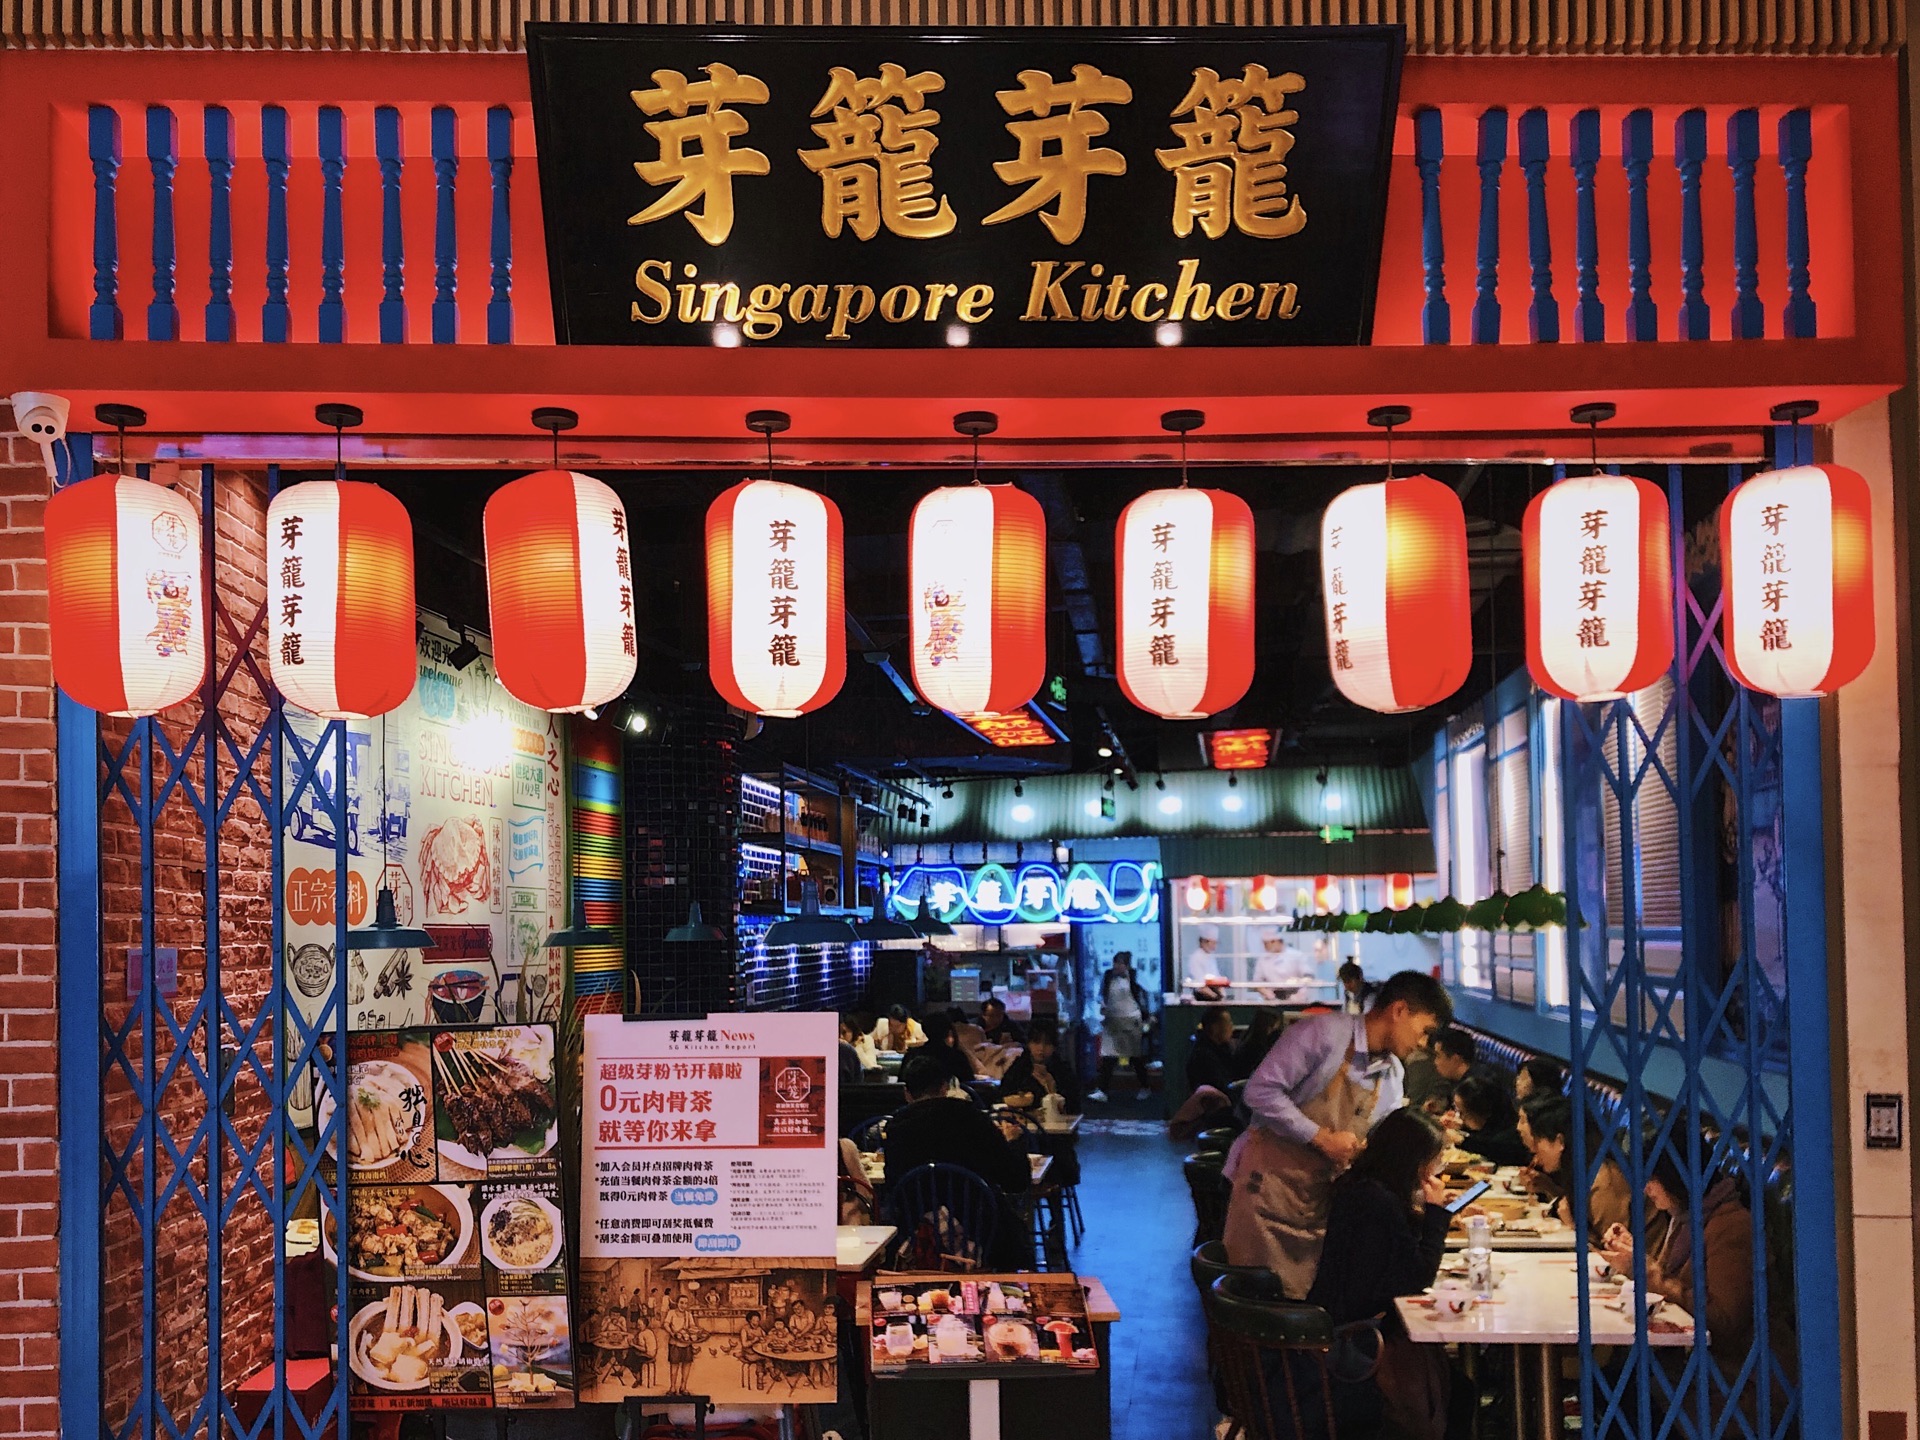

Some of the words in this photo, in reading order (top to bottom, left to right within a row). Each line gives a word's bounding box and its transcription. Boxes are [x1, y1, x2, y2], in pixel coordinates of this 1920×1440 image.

[627, 62, 1307, 245] 芽籠芽籠
[631, 259, 995, 341] Singapore
[1019, 259, 1300, 323] Kitchen
[280, 515, 305, 666] 芽籠芽籠
[612, 507, 636, 658] 芽籠芽籠
[1576, 509, 1611, 649] 芽籠芽籠
[1759, 503, 1792, 651] 芽籠芽籠
[767, 519, 801, 667] 芽籠芽籠
[1149, 522, 1180, 667] 芽籠芽籠
[419, 636, 457, 667] 欢迎光
[419, 663, 464, 688] welcome
[419, 764, 494, 806] KITCHEN
[515, 762, 544, 784] 世纪大道
[669, 1029, 718, 1042] 芽籠芽籠
[720, 1029, 755, 1042] News
[725, 1043, 756, 1052] Report
[600, 1062, 743, 1081] 超级芽粉节开幕啦
[600, 1084, 713, 1114] 0元肉骨茶
[598, 1119, 717, 1143] 就等你来拿
[600, 1160, 714, 1172] 加入会员并点招牌肉骨茶
[600, 1175, 719, 1187] 充值当餐肉骨茶金额的4倍
[600, 1218, 714, 1229] 任意消费即可刮奖抵餐费
[600, 1232, 693, 1244] 刮奖金额可叠加使用
